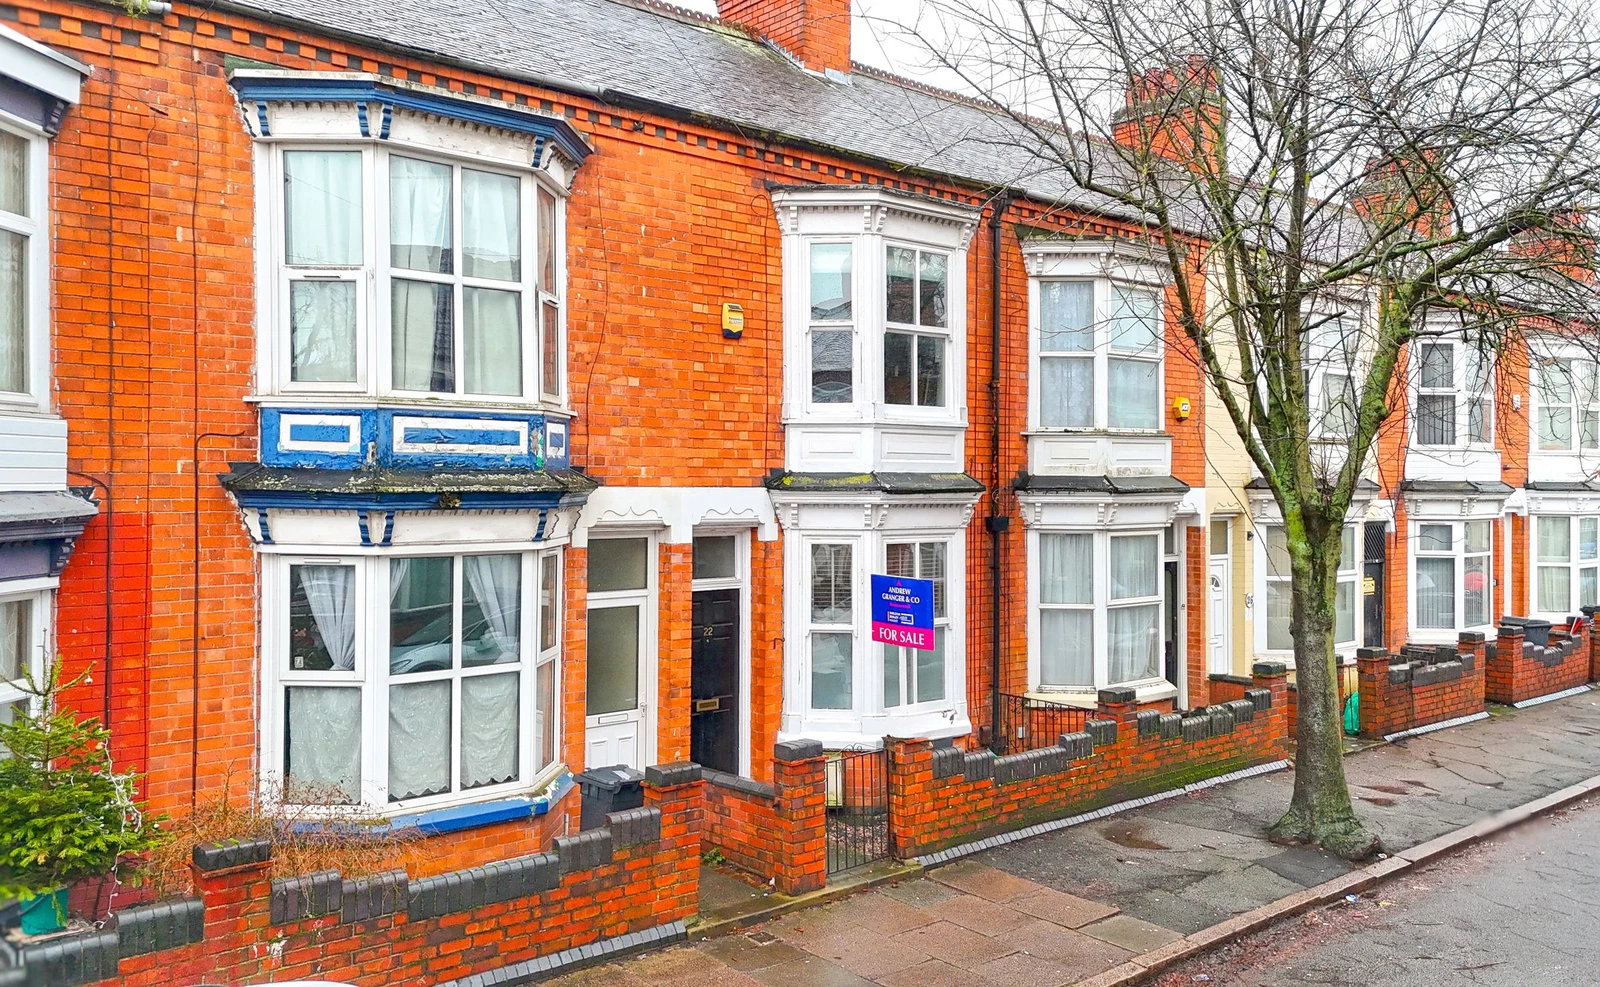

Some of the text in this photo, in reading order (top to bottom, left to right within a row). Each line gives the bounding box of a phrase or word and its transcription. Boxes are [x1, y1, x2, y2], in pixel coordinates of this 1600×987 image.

[882, 593, 905, 602] GRANGER
[703, 627, 713, 636] 22
[879, 627, 924, 645] FOR SALE
